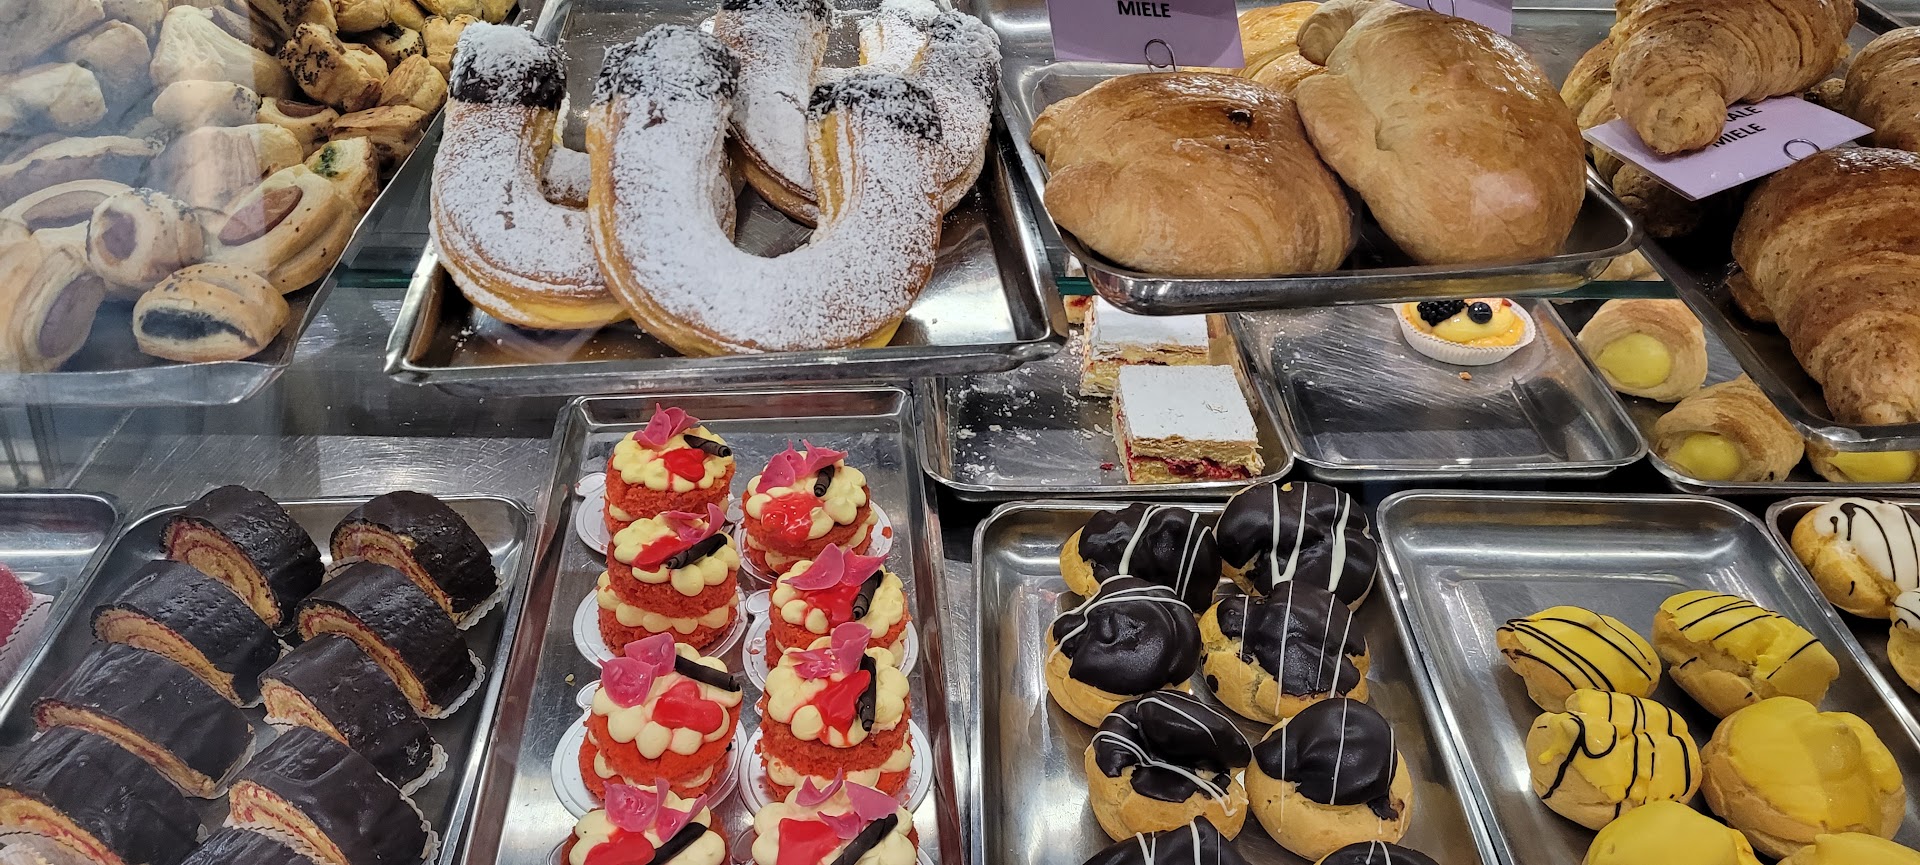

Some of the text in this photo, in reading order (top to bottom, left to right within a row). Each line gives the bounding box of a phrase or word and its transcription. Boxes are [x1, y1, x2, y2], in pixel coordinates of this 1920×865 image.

[1117, 0, 1171, 18] MIELE
[1726, 106, 1763, 122] ALE
[1712, 123, 1767, 148] MIELE
